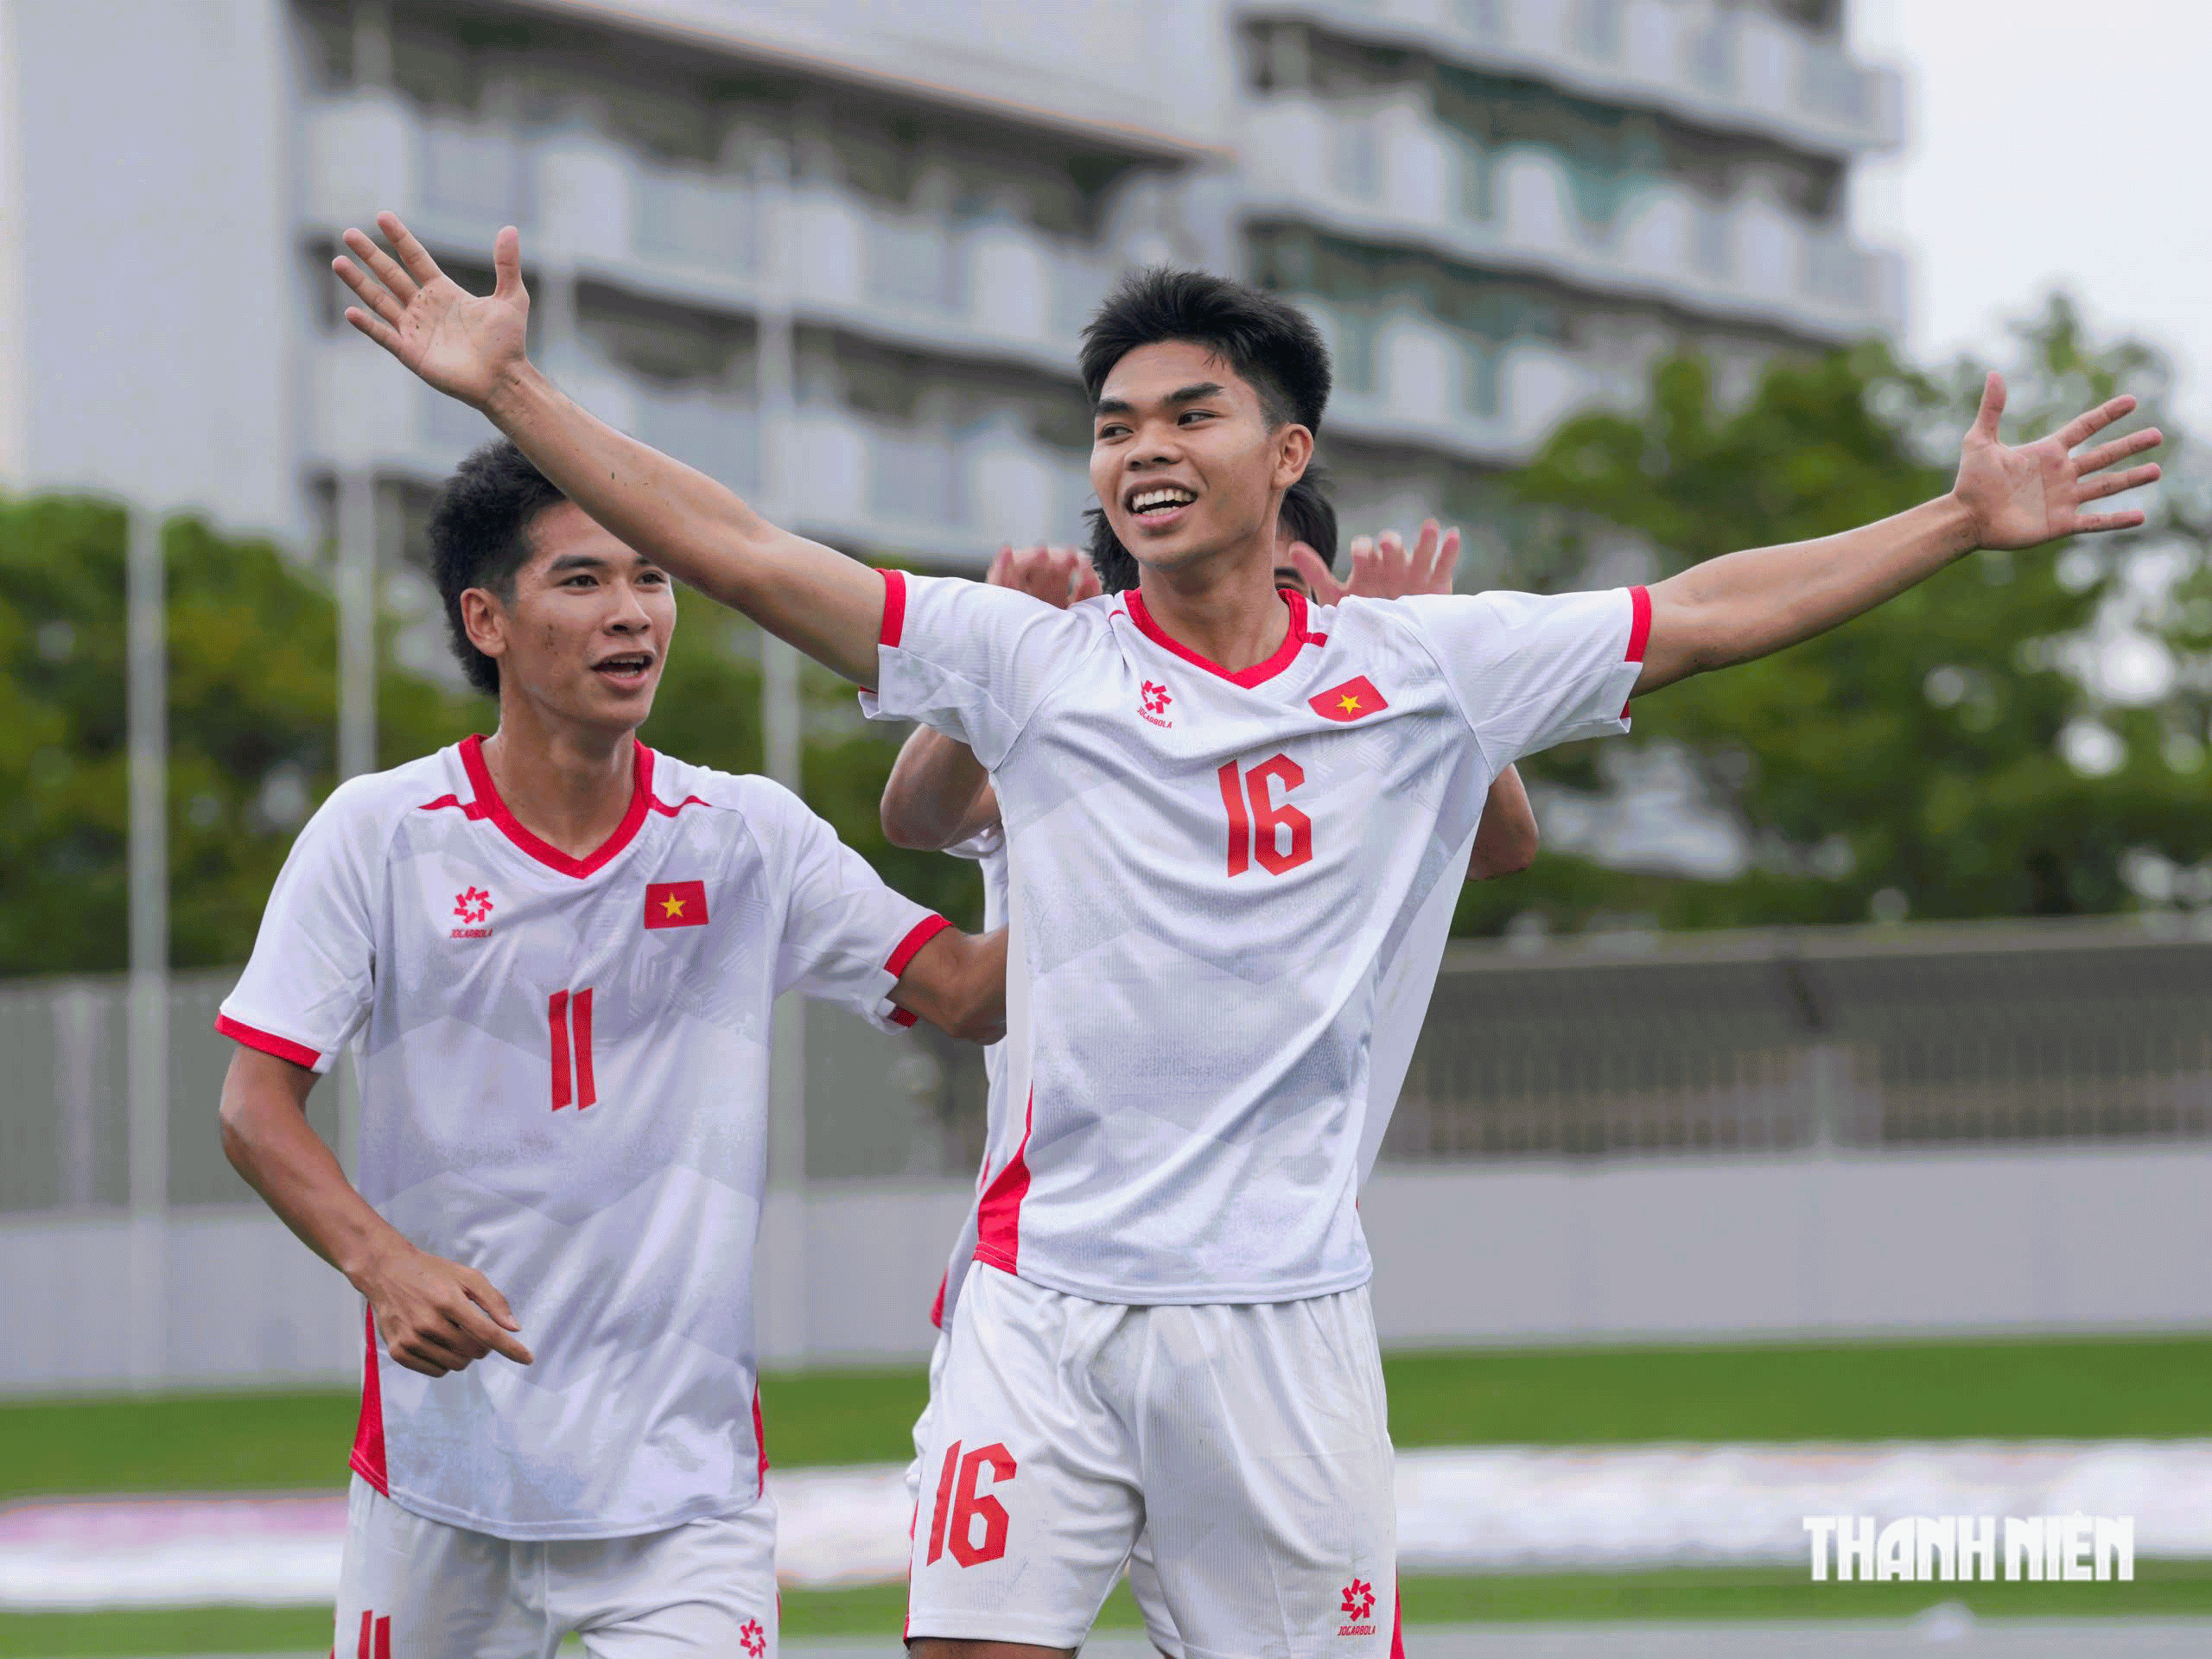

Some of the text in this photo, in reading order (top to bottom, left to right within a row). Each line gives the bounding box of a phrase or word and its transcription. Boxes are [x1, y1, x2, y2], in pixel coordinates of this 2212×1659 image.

[1217, 753, 1313, 877] 16
[548, 987, 596, 1111] 11
[926, 1440, 1017, 1568] 16
